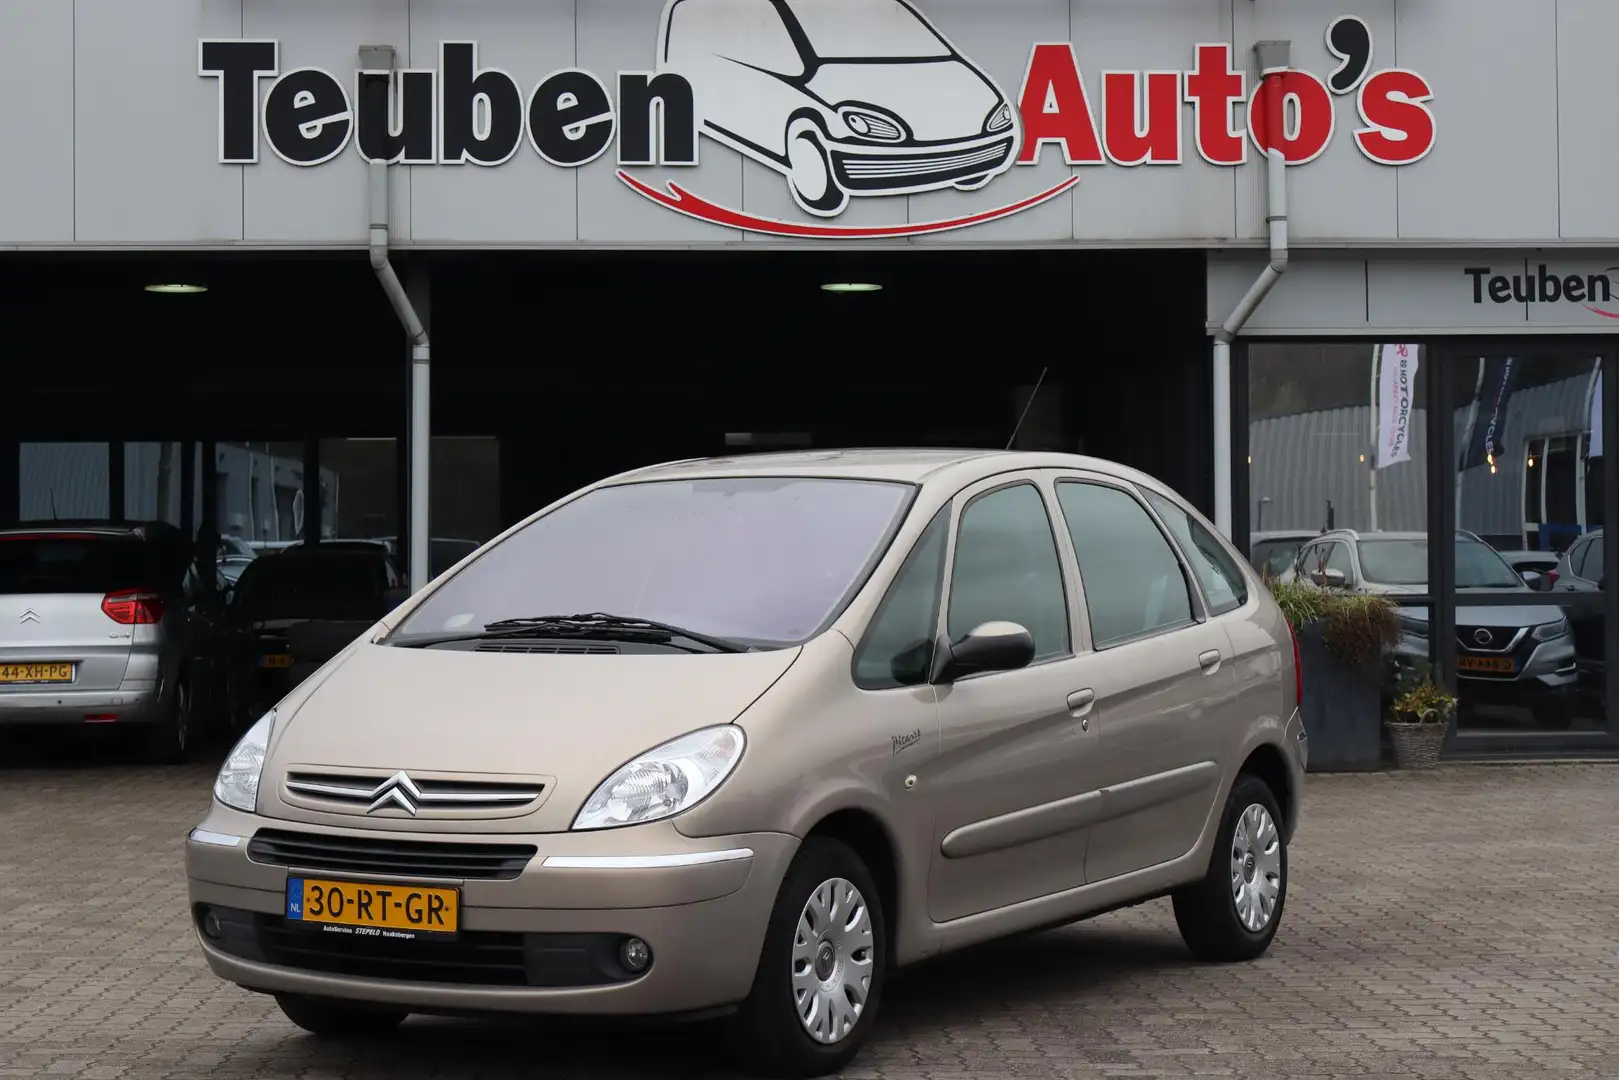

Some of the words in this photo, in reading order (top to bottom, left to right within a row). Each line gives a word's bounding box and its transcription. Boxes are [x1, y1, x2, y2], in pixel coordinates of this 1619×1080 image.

[199, 39, 698, 166] Teuben
[1016, 15, 1437, 166] Auto's
[1464, 264, 1611, 303] Teuben
[2, 666, 67, 678] 44-XH-PG
[290, 903, 301, 913] NL
[309, 885, 444, 925] 30-RT-GR
[355, 927, 381, 936] STEPELO
